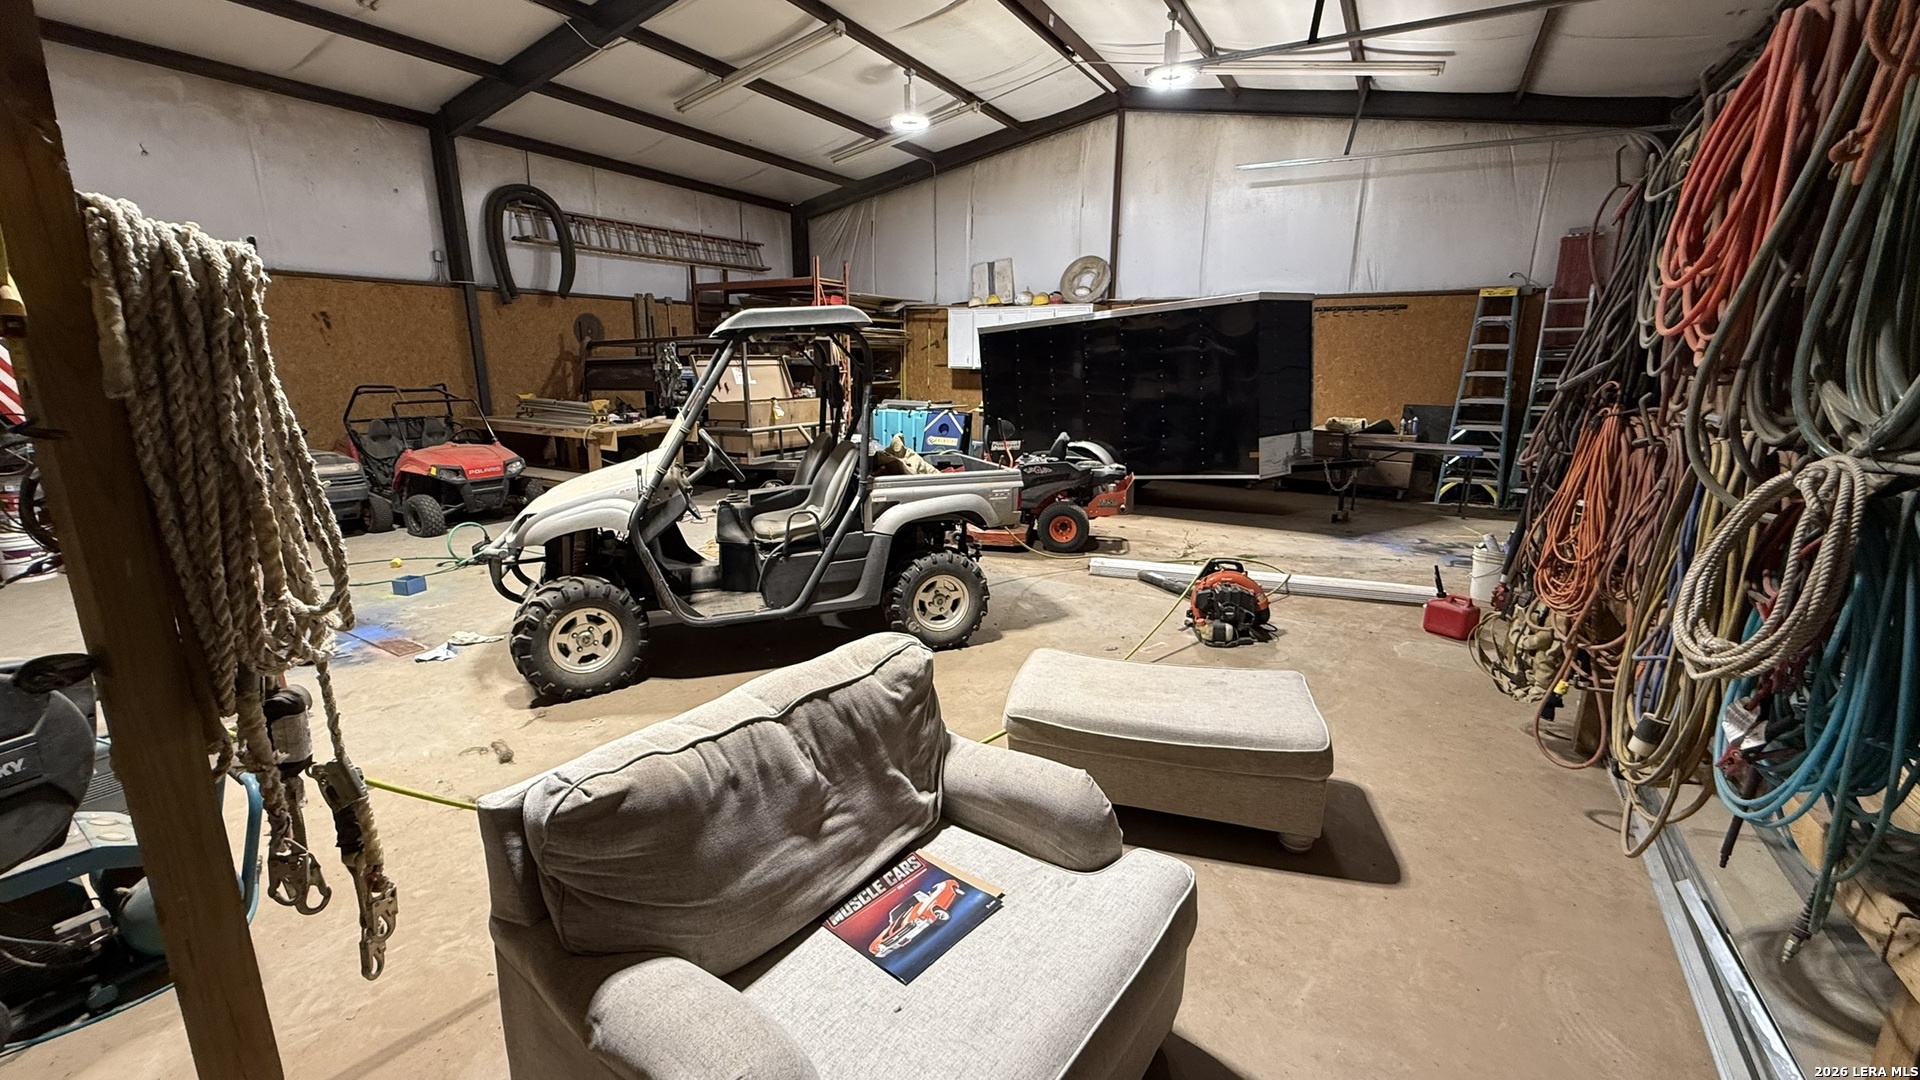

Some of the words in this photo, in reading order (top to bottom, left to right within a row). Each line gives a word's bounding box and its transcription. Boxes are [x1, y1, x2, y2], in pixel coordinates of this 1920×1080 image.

[468, 466, 501, 475] POLARIS
[828, 879, 887, 926] MUSCLE
[883, 855, 922, 886] CARS
